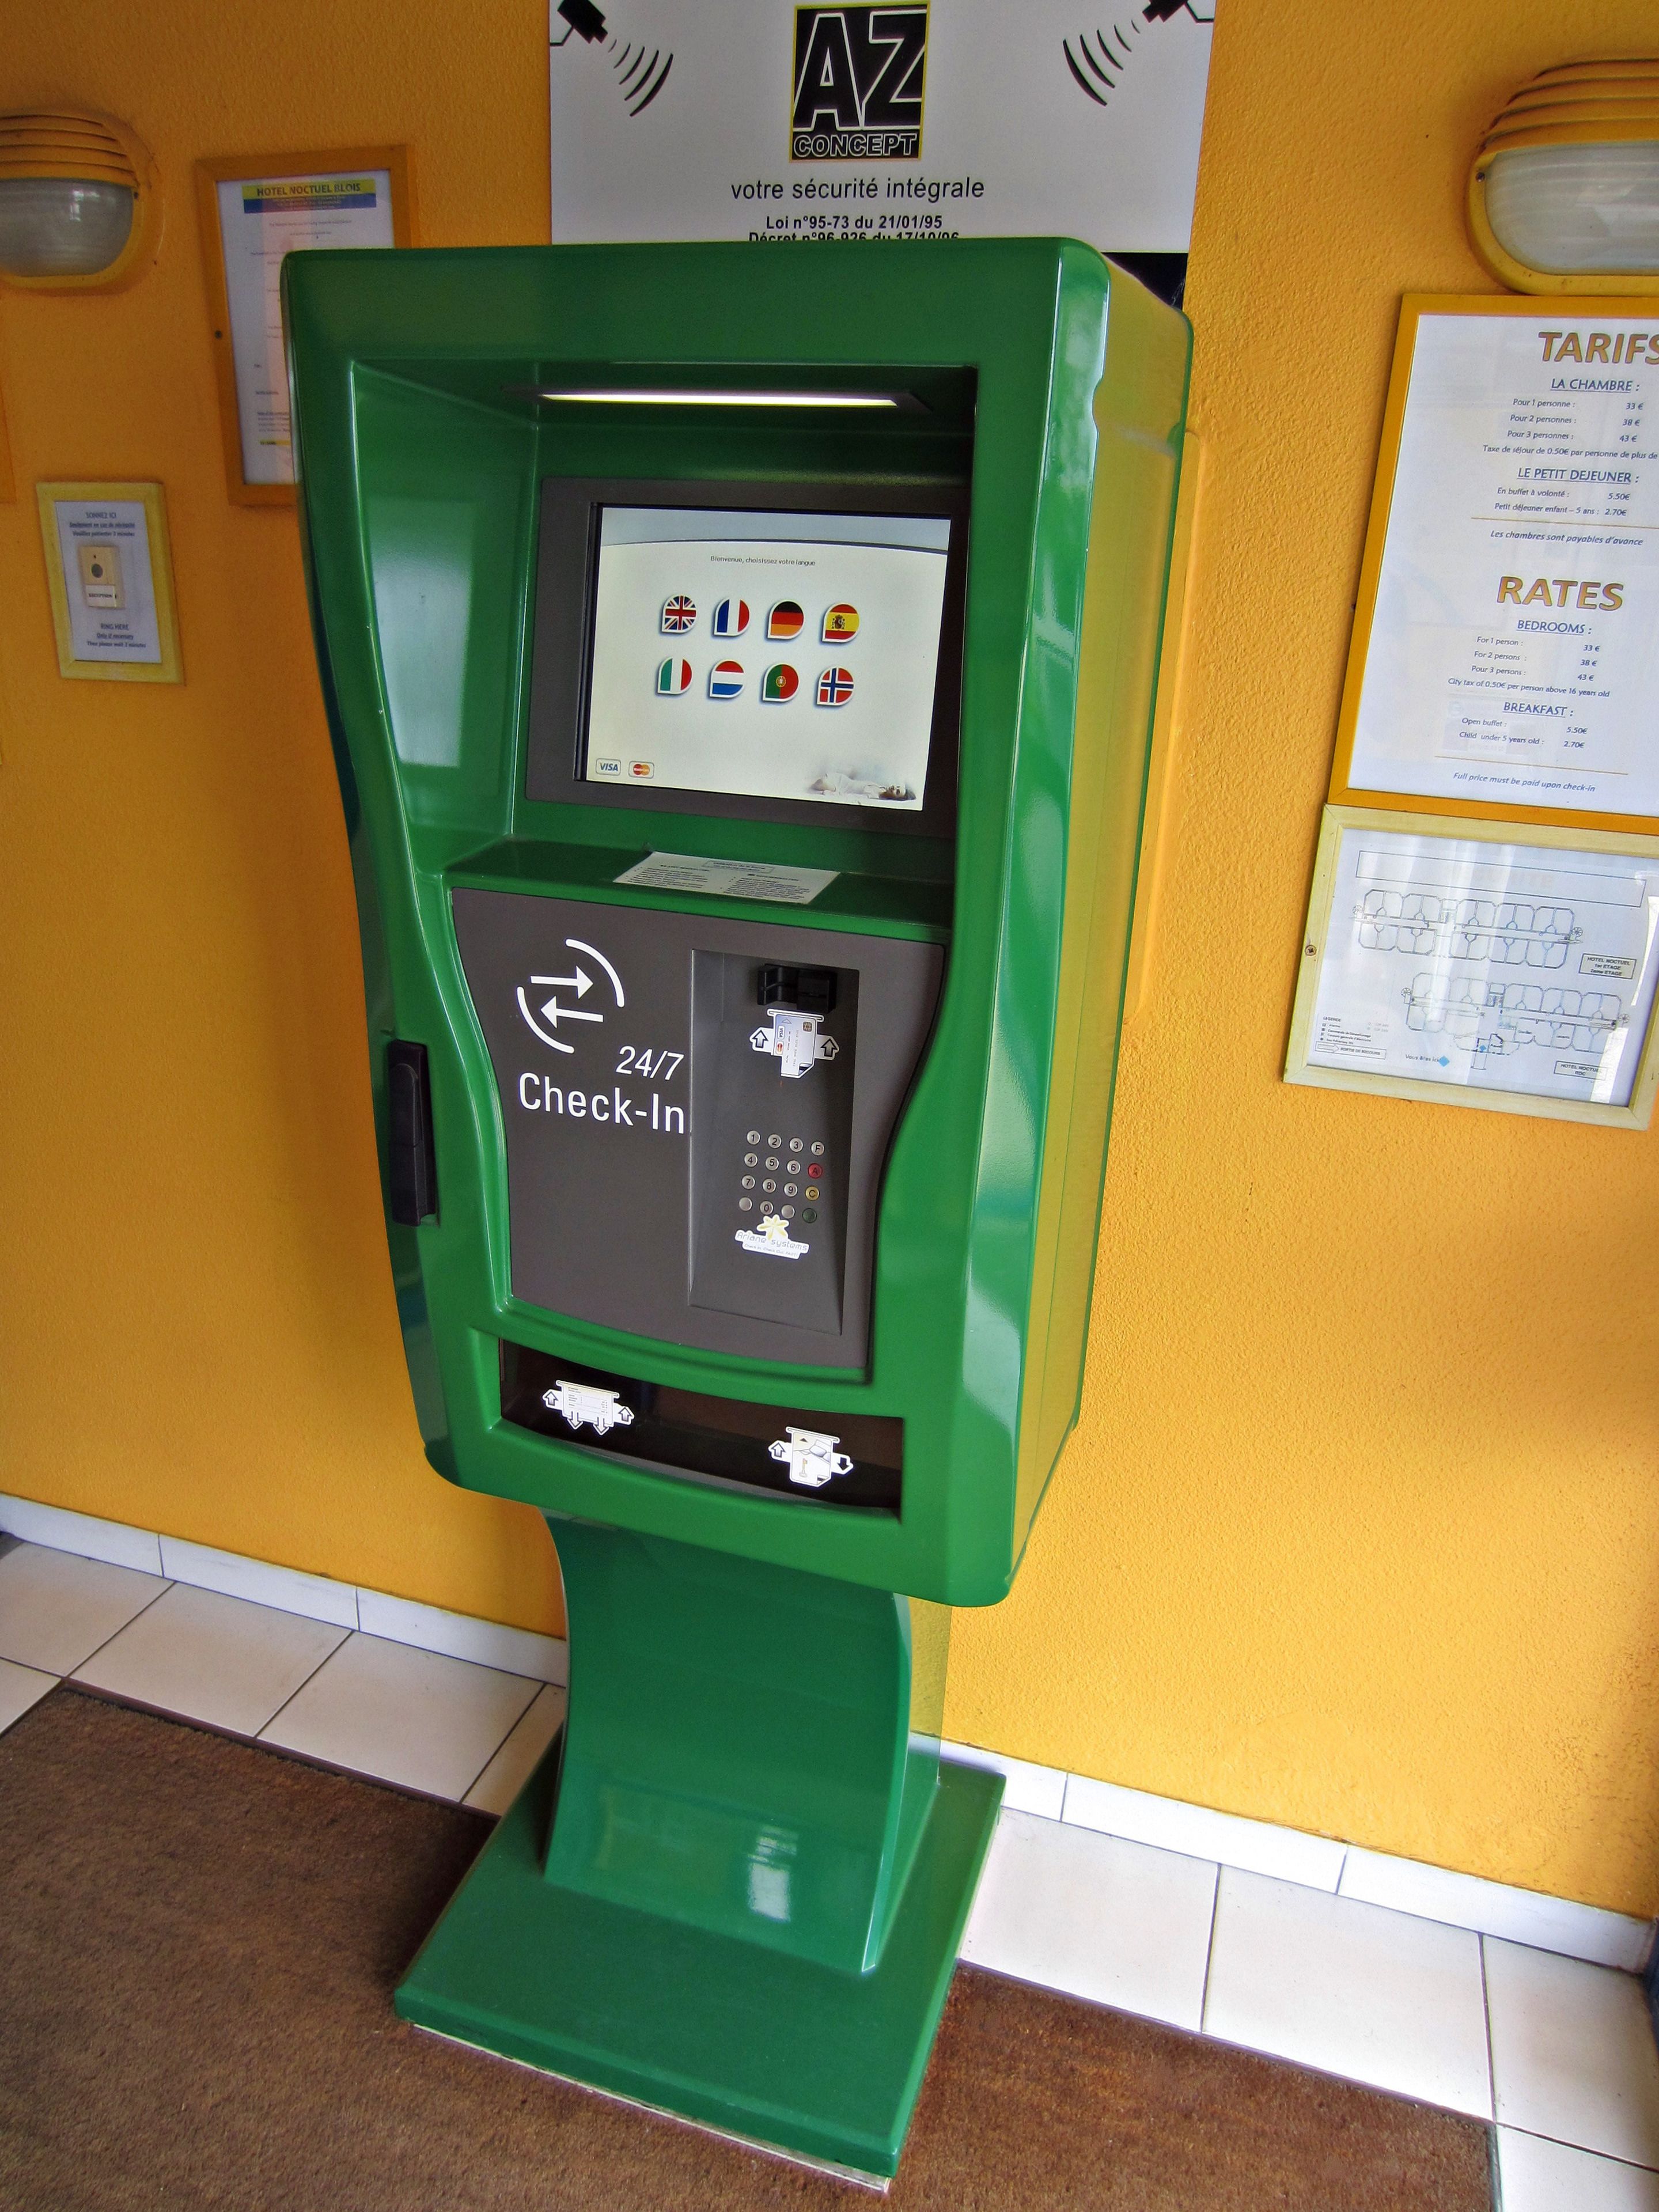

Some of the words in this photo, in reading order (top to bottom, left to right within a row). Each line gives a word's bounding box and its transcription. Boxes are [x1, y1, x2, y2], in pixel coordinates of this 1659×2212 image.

[794, 8, 929, 131] AZ
[794, 132, 916, 158] CONCEPT
[257, 187, 287, 196] HOTEL
[290, 184, 332, 194] NOCTUEL
[334, 183, 361, 192] BLOIS
[731, 181, 783, 200] votre
[793, 177, 878, 200] sécurité
[886, 176, 984, 203] intégrale
[766, 215, 789, 229] Loi
[794, 215, 850, 229] n°95-73
[855, 215, 873, 229] du
[878, 215, 942, 229] 21/01/95
[1537, 331, 1659, 365] TARIFS
[1551, 378, 1567, 389] LA
[1570, 379, 1633, 391] CHAMBRE
[1537, 400, 1571, 409] personne
[1536, 417, 1572, 425] personnes
[1533, 433, 1569, 441] personnes
[1513, 446, 1535, 455] séjour
[1570, 450, 1583, 458] par
[1585, 450, 1618, 459] personne
[1620, 450, 1630, 459] de
[1631, 451, 1646, 461] plus
[1518, 468, 1531, 478] LE
[1533, 468, 1567, 479] PETIT
[1570, 470, 1631, 483] DEJEUNER
[1537, 490, 1565, 498] volonté
[1608, 493, 1630, 501] 5.50€
[1512, 503, 1543, 513] déjeuner
[1605, 508, 1627, 516] 2.70€
[1491, 529, 1503, 538] Les
[1505, 530, 1544, 540] chambres
[1547, 532, 1565, 541] sont
[1566, 533, 1603, 544] payables
[1605, 535, 1643, 546] d'avance
[710, 555, 744, 564] Bienvenue,
[796, 559, 816, 567] langue
[1496, 575, 1624, 612] RATES
[1517, 620, 1584, 634] BEDROOMS
[1495, 639, 1519, 647] person
[1496, 668, 1522, 676] persons
[1448, 678, 1462, 686] City
[1520, 685, 1544, 693] person
[1546, 686, 1567, 694] above
[1578, 689, 1596, 697] years
[1503, 702, 1568, 717] BREAKFAST
[1461, 718, 1480, 727] Open
[1483, 719, 1503, 727] buffet
[1481, 733, 1501, 741] under
[1509, 737, 1527, 745] years
[1563, 741, 1585, 749] 2.70€
[599, 762, 619, 772] VISA
[1453, 772, 1467, 781] Full
[1468, 774, 1488, 783] price
[1522, 779, 1540, 788] paid
[1563, 783, 1595, 793] check-in
[616, 1046, 684, 1081] 24/7
[519, 1072, 685, 1134] Check-In
[794, 1141, 799, 1149] 3
[815, 1145, 821, 1153] F
[770, 1158, 775, 1166] 5
[791, 1163, 796, 1172] 6
[788, 1185, 793, 1194] 9
[809, 1190, 816, 1198] C
[764, 1204, 769, 1212] 0
[737, 1232, 767, 1243] Ariane
[771, 1239, 808, 1251] systems
